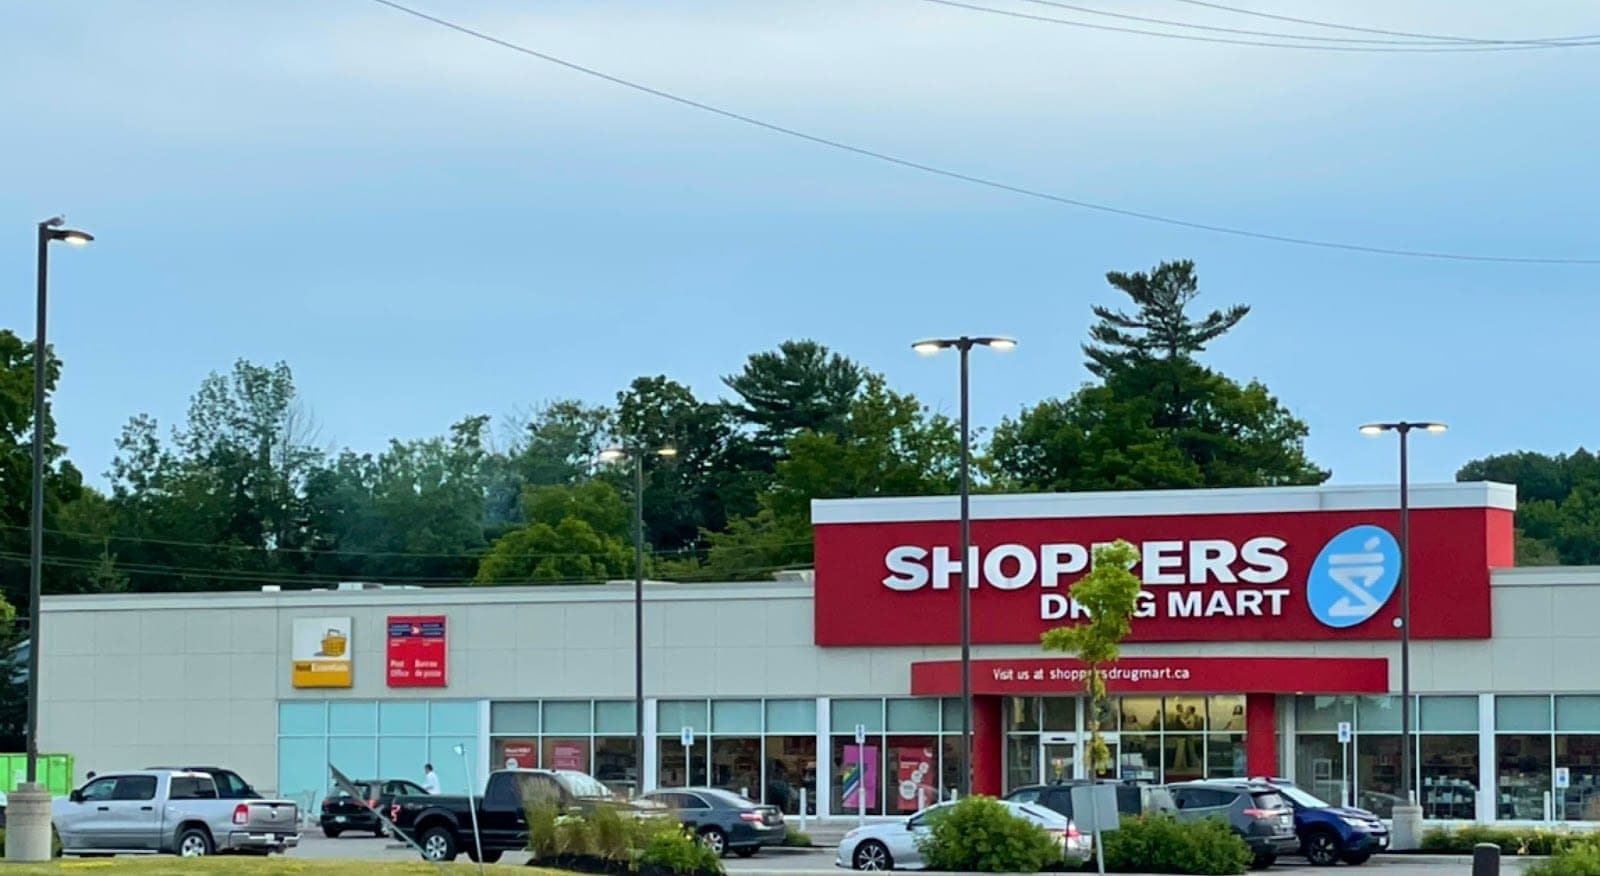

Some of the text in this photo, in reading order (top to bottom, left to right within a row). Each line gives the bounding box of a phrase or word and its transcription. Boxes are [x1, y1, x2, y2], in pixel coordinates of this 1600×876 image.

[1040, 589, 1290, 620] DRG MART
[993, 668, 1013, 680] Visit
[1017, 670, 1030, 680] us
[1033, 668, 1044, 680] at
